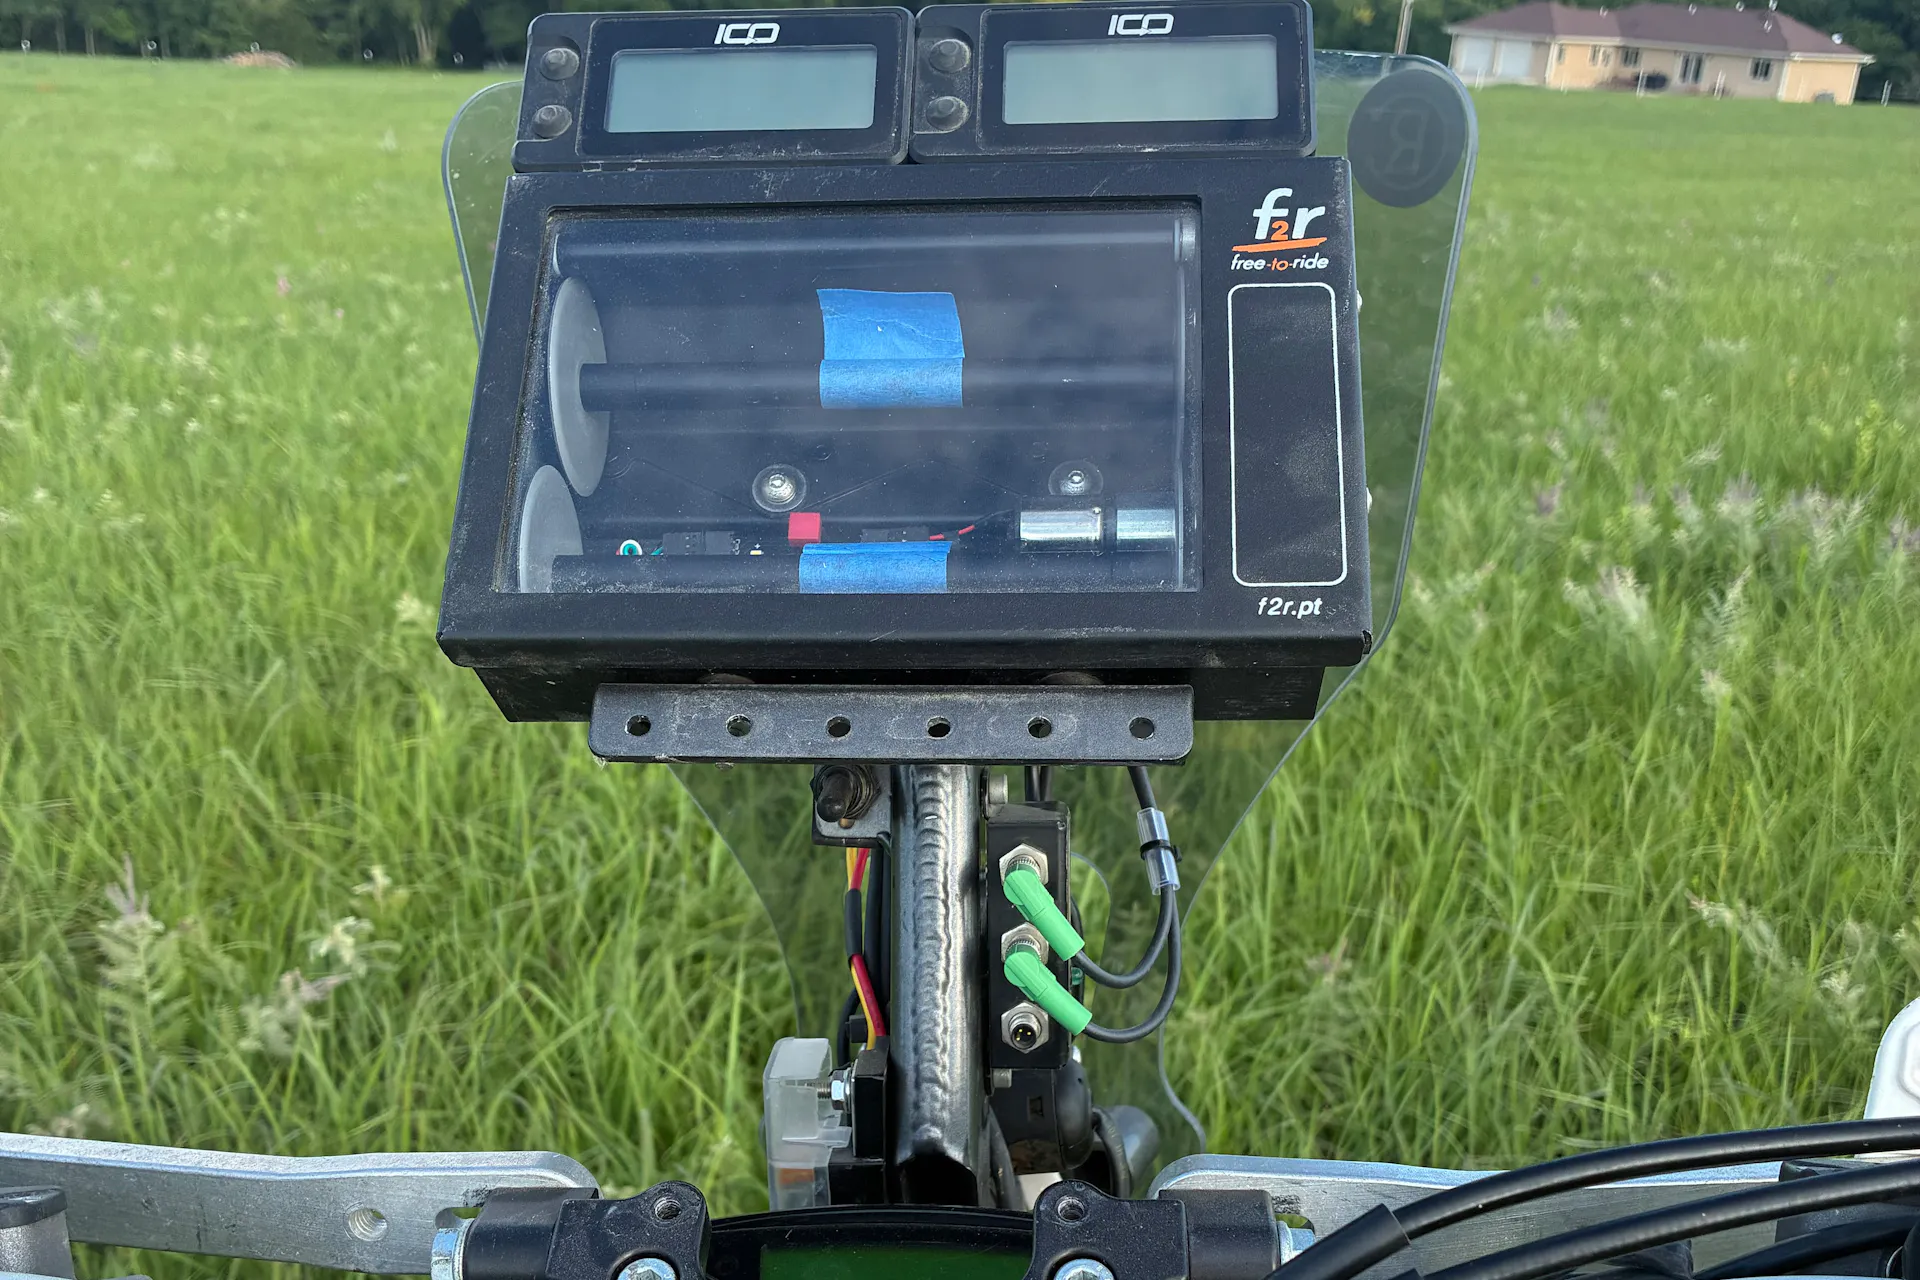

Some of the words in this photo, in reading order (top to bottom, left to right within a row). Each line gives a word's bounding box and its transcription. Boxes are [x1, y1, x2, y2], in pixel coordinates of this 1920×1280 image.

[1253, 188, 1326, 240] f2r
[1231, 252, 1329, 271] free-to-ride
[1258, 597, 1323, 619] f2r.pt
